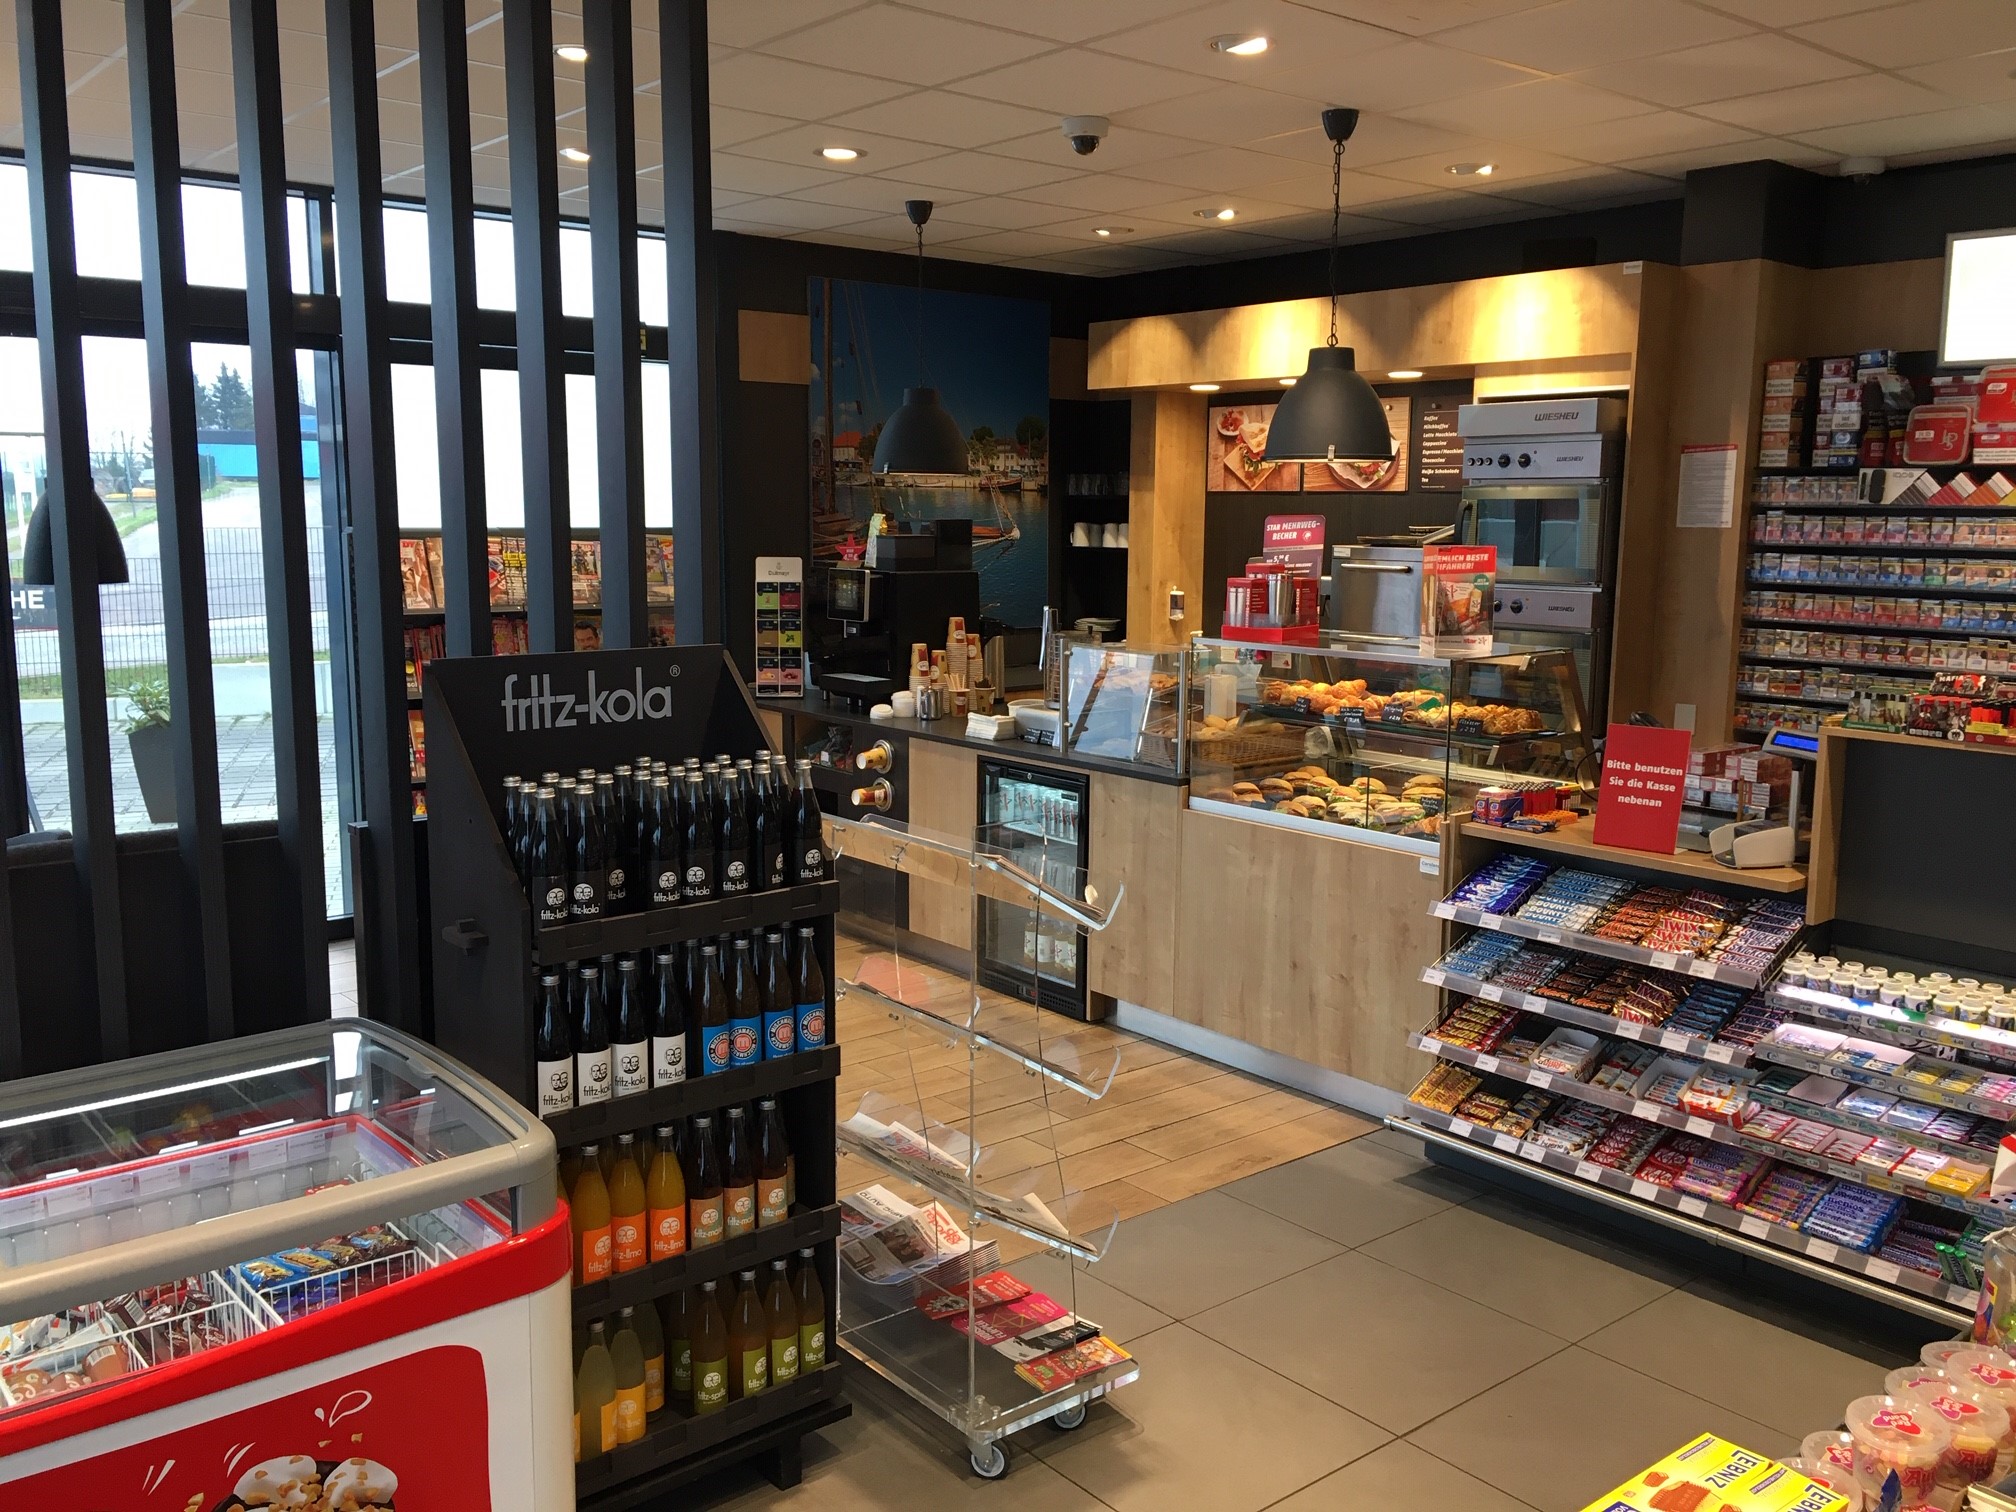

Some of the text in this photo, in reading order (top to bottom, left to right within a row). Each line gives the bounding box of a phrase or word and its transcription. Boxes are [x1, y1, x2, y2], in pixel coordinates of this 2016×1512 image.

[1534, 412, 1579, 421] WIESHEU
[1266, 520, 1320, 532] STAR MEHRWEG-
[1272, 532, 1298, 540] BECHER
[1606, 759, 1683, 776] Bitte benutzen
[1609, 776, 1676, 792] Sie die Kasse
[1618, 794, 1662, 808] nebenan
[1529, 906, 1568, 919] BOUNTY
[1536, 900, 1576, 914] BOUNTY
[1661, 917, 1701, 934] TWIX
[1655, 929, 1692, 942] TWIX
[1742, 929, 1786, 945] SNICKERS
[1729, 942, 1775, 960] SNICKERS
[1452, 958, 1486, 971] BOUNTY
[1722, 952, 1768, 968] SNICKERS
[614, 1074, 646, 1088] fritz-kola
[1471, 1106, 1496, 1120] LION
[1540, 1140, 1564, 1152] bueno
[1655, 1150, 1687, 1166] KitKat
[1693, 1158, 1726, 1172] mentos
[1641, 1167, 1673, 1182] KitKat
[1686, 1173, 1718, 1187] mentos
[1772, 1177, 1807, 1190] mentos
[1842, 1183, 1878, 1199] mentos
[1828, 1197, 1864, 1213] mentos
[1807, 1224, 1840, 1241] mentos
[654, 1240, 684, 1252] fritz-limo
[698, 1387, 728, 1402] fritz-spritz
[1883, 1413, 1909, 1422] Band
[1890, 1418, 1911, 1427] Red
[1704, 1450, 1765, 1489] LEIBNIZ
